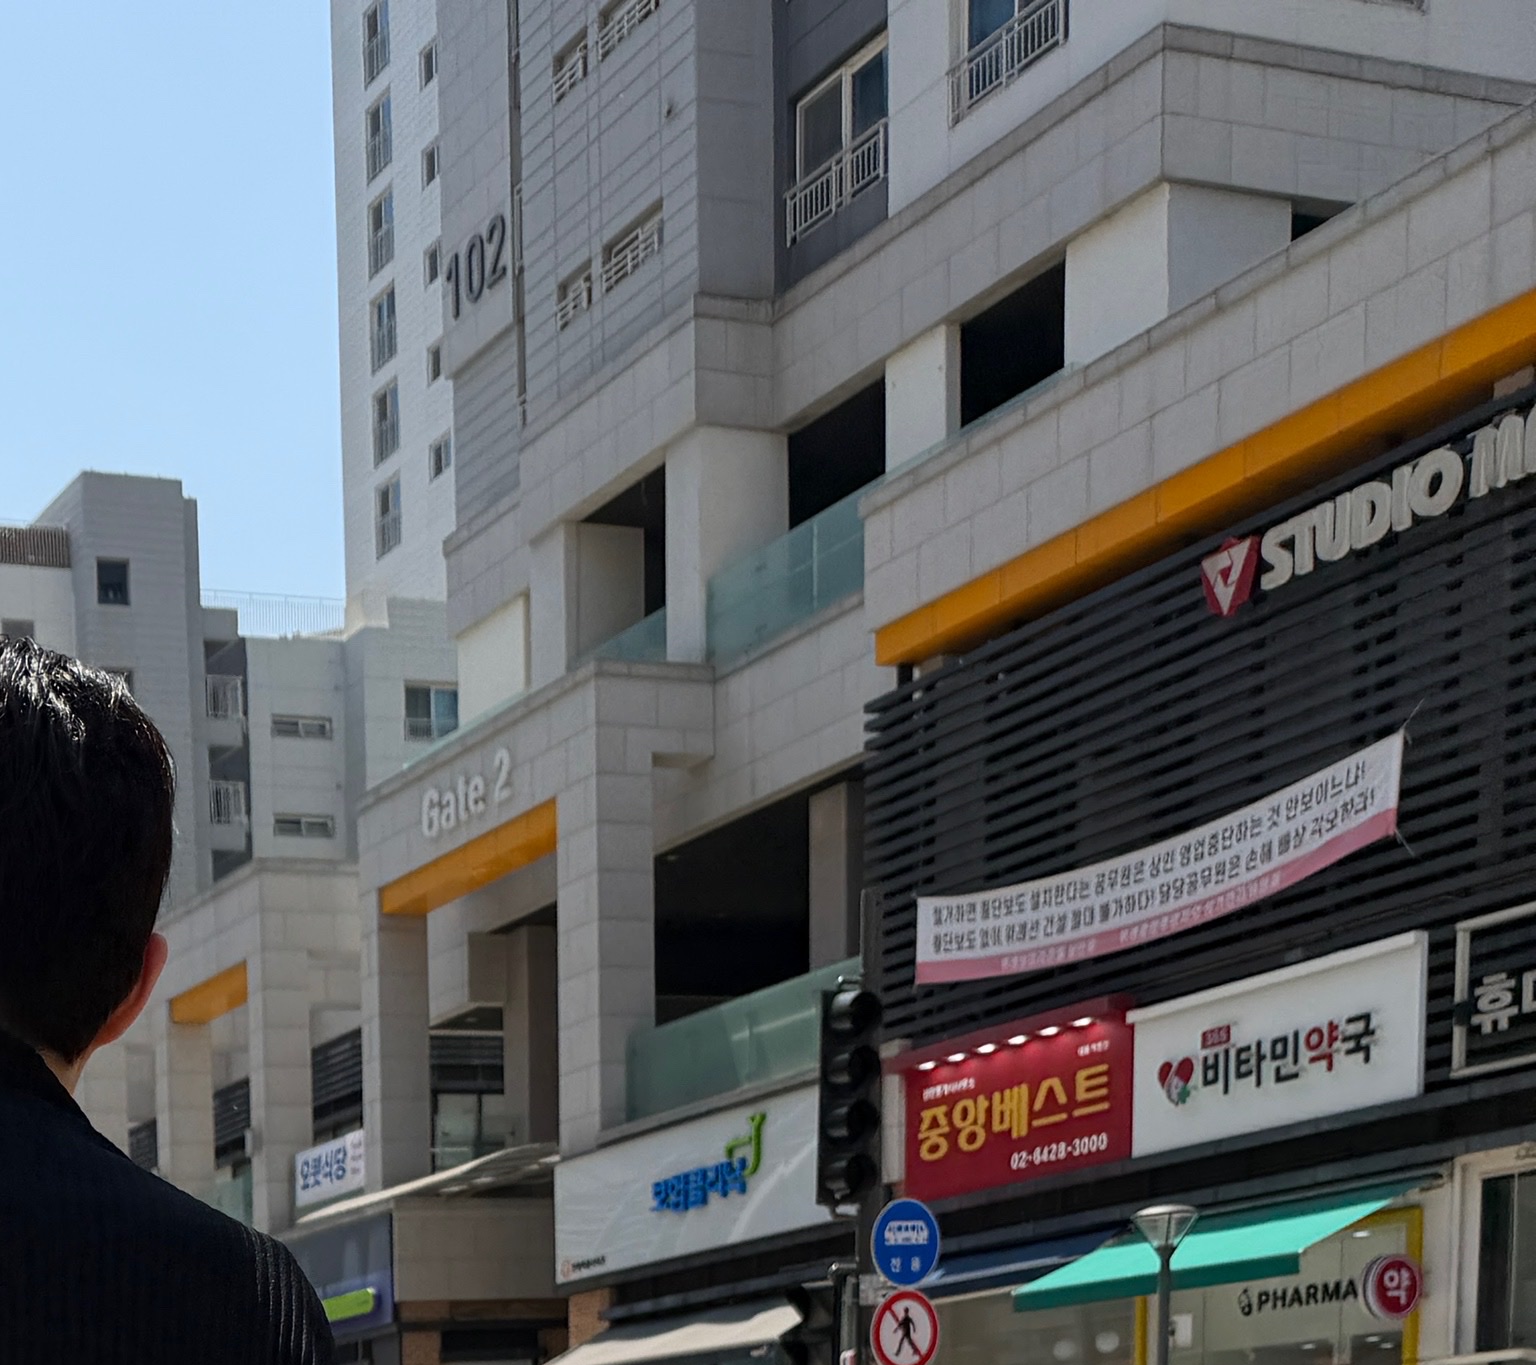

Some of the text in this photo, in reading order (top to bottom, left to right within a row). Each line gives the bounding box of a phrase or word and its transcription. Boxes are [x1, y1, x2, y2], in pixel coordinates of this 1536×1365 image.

[446, 213, 507, 320] 102
[1261, 446, 1464, 591] STUDIO
[422, 748, 511, 838] Gate 2
[1470, 971, 1536, 1035] 휴
[1202, 1011, 1376, 1096] 비타민약국
[918, 1063, 1111, 1162] 중앙베스트
[1257, 1277, 1359, 1314] PHARMA
[1383, 1266, 1412, 1307] 약
